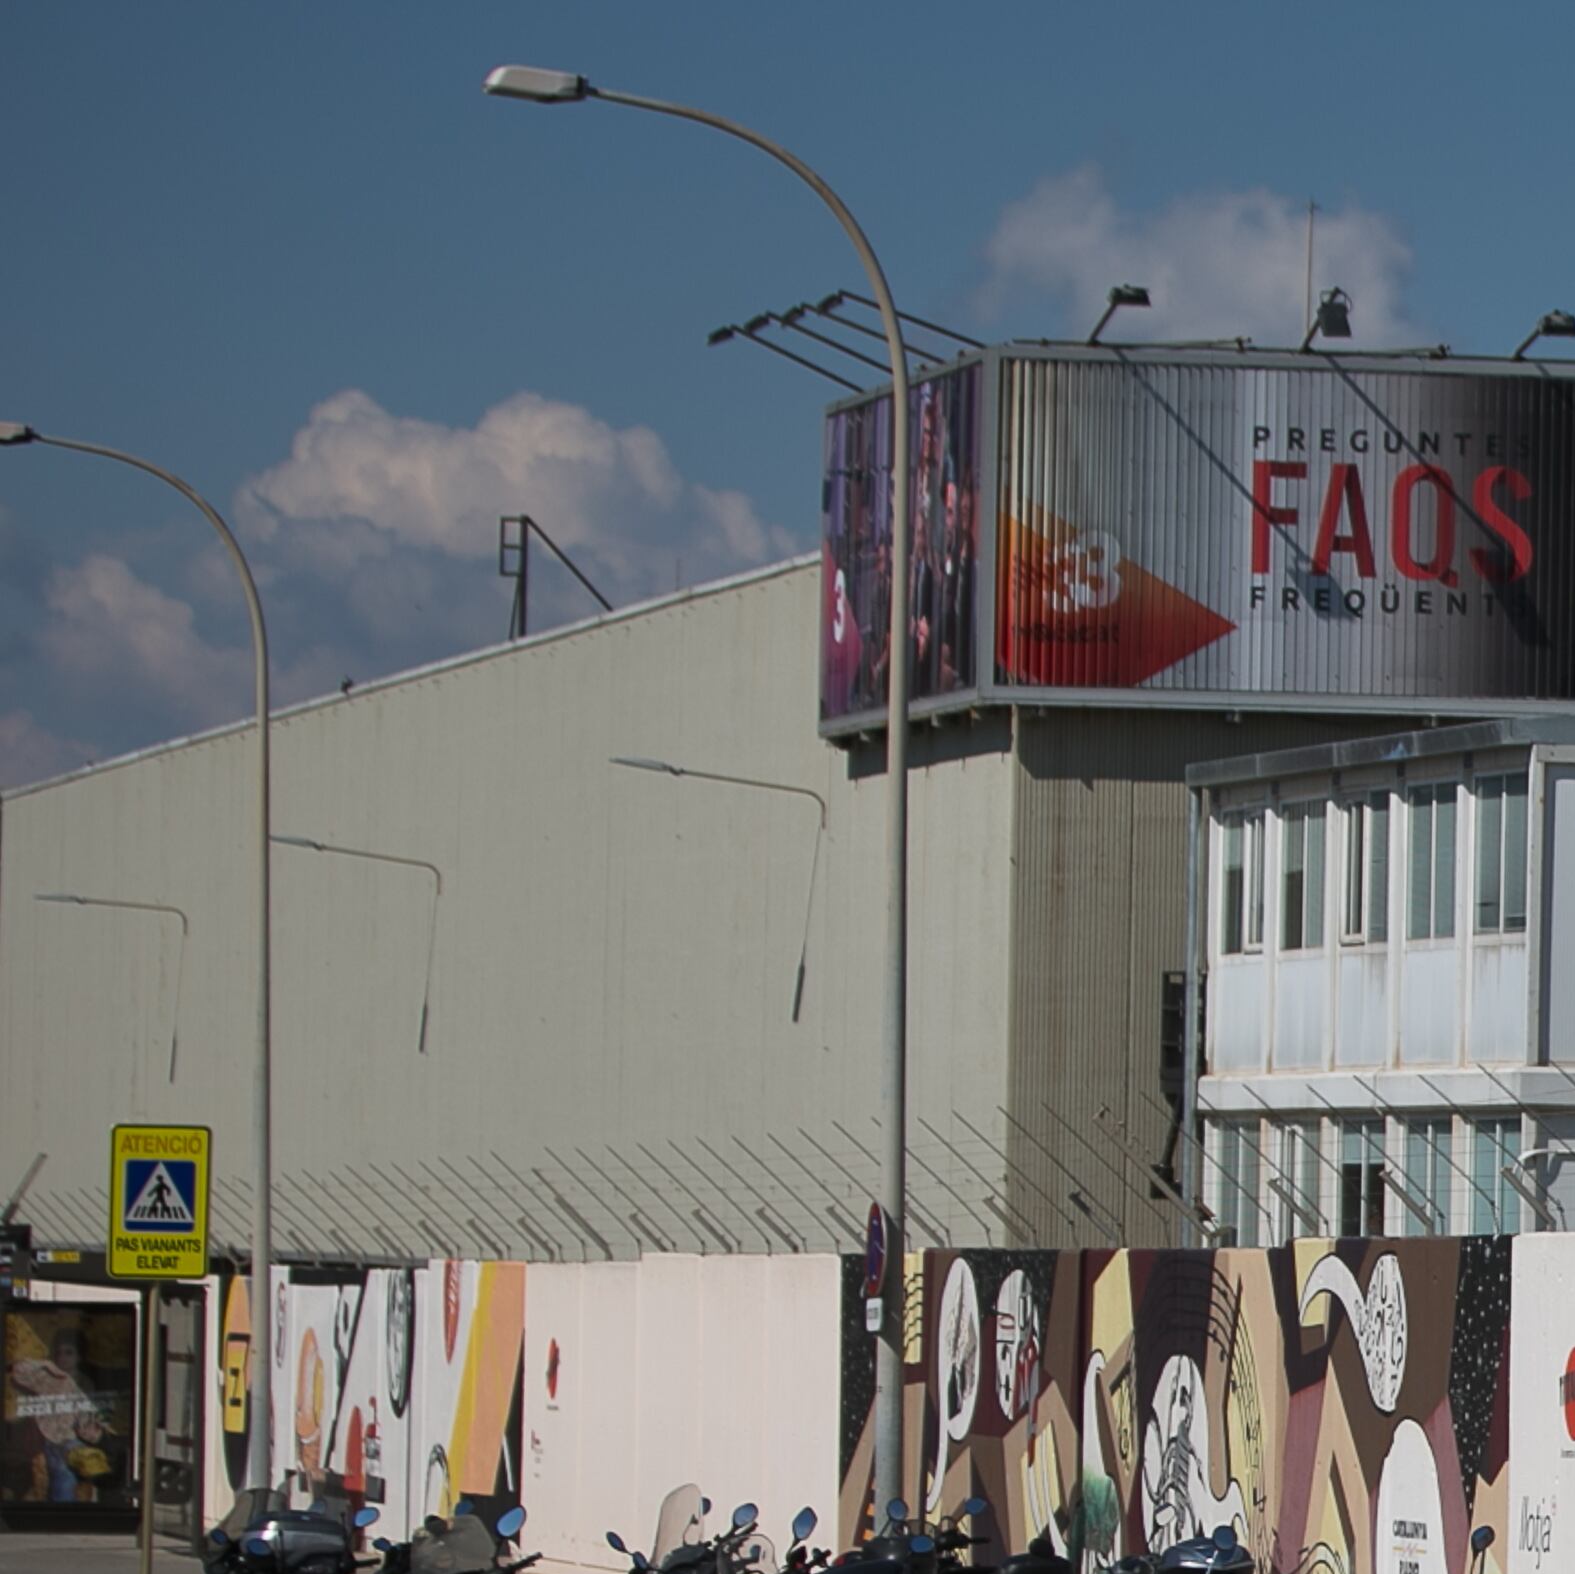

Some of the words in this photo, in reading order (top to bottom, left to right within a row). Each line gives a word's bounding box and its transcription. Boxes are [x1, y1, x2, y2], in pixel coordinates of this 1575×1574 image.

[1250, 460, 1534, 588] FAQS
[120, 1132, 202, 1154] ATENCIÓ
[116, 1237, 139, 1251] PAS
[142, 1238, 201, 1252] VIANANTS
[136, 1255, 180, 1269] ELEVAT
